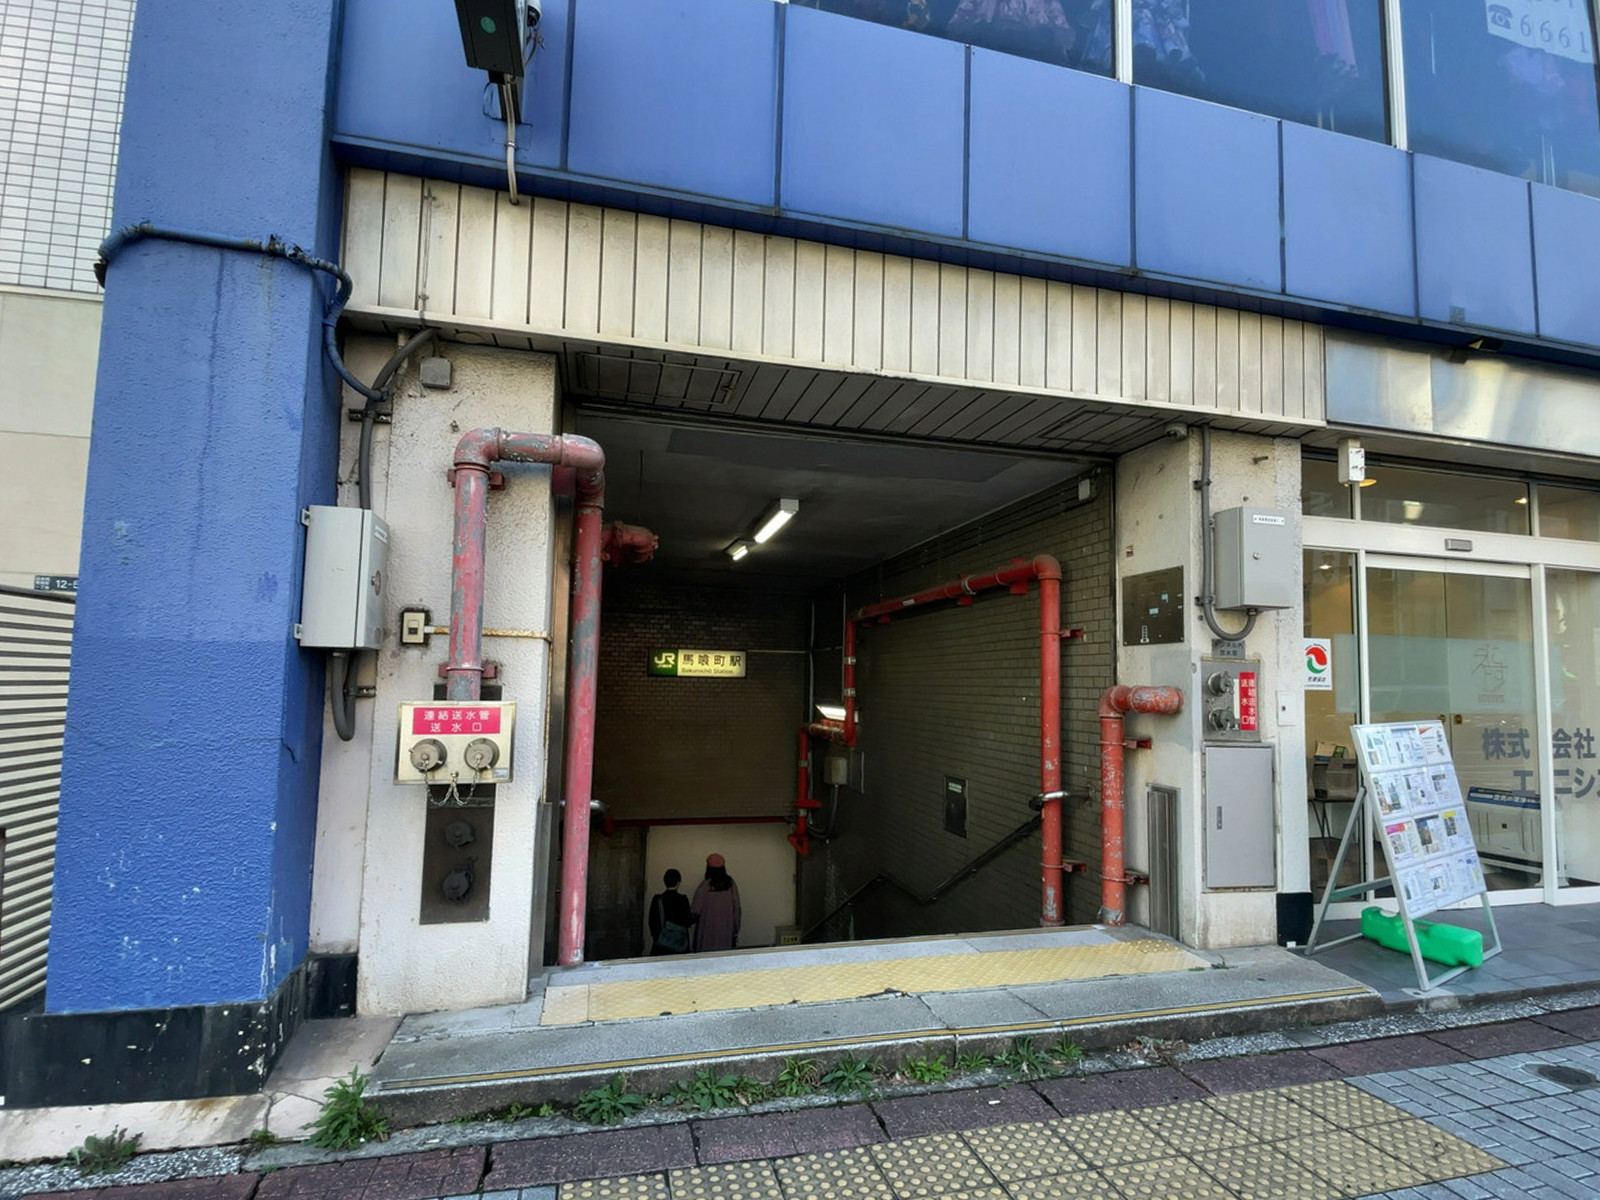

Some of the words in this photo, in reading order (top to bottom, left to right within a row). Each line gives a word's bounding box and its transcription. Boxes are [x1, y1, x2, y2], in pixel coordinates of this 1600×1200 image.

[1520, 14, 1588, 53] 6661
[654, 652, 676, 665] JR
[681, 653, 742, 667] 馬喰町駅
[423, 710, 491, 721] 連結送水管
[430, 722, 483, 733] 送水口
[1511, 766, 1600, 799] エニシ
